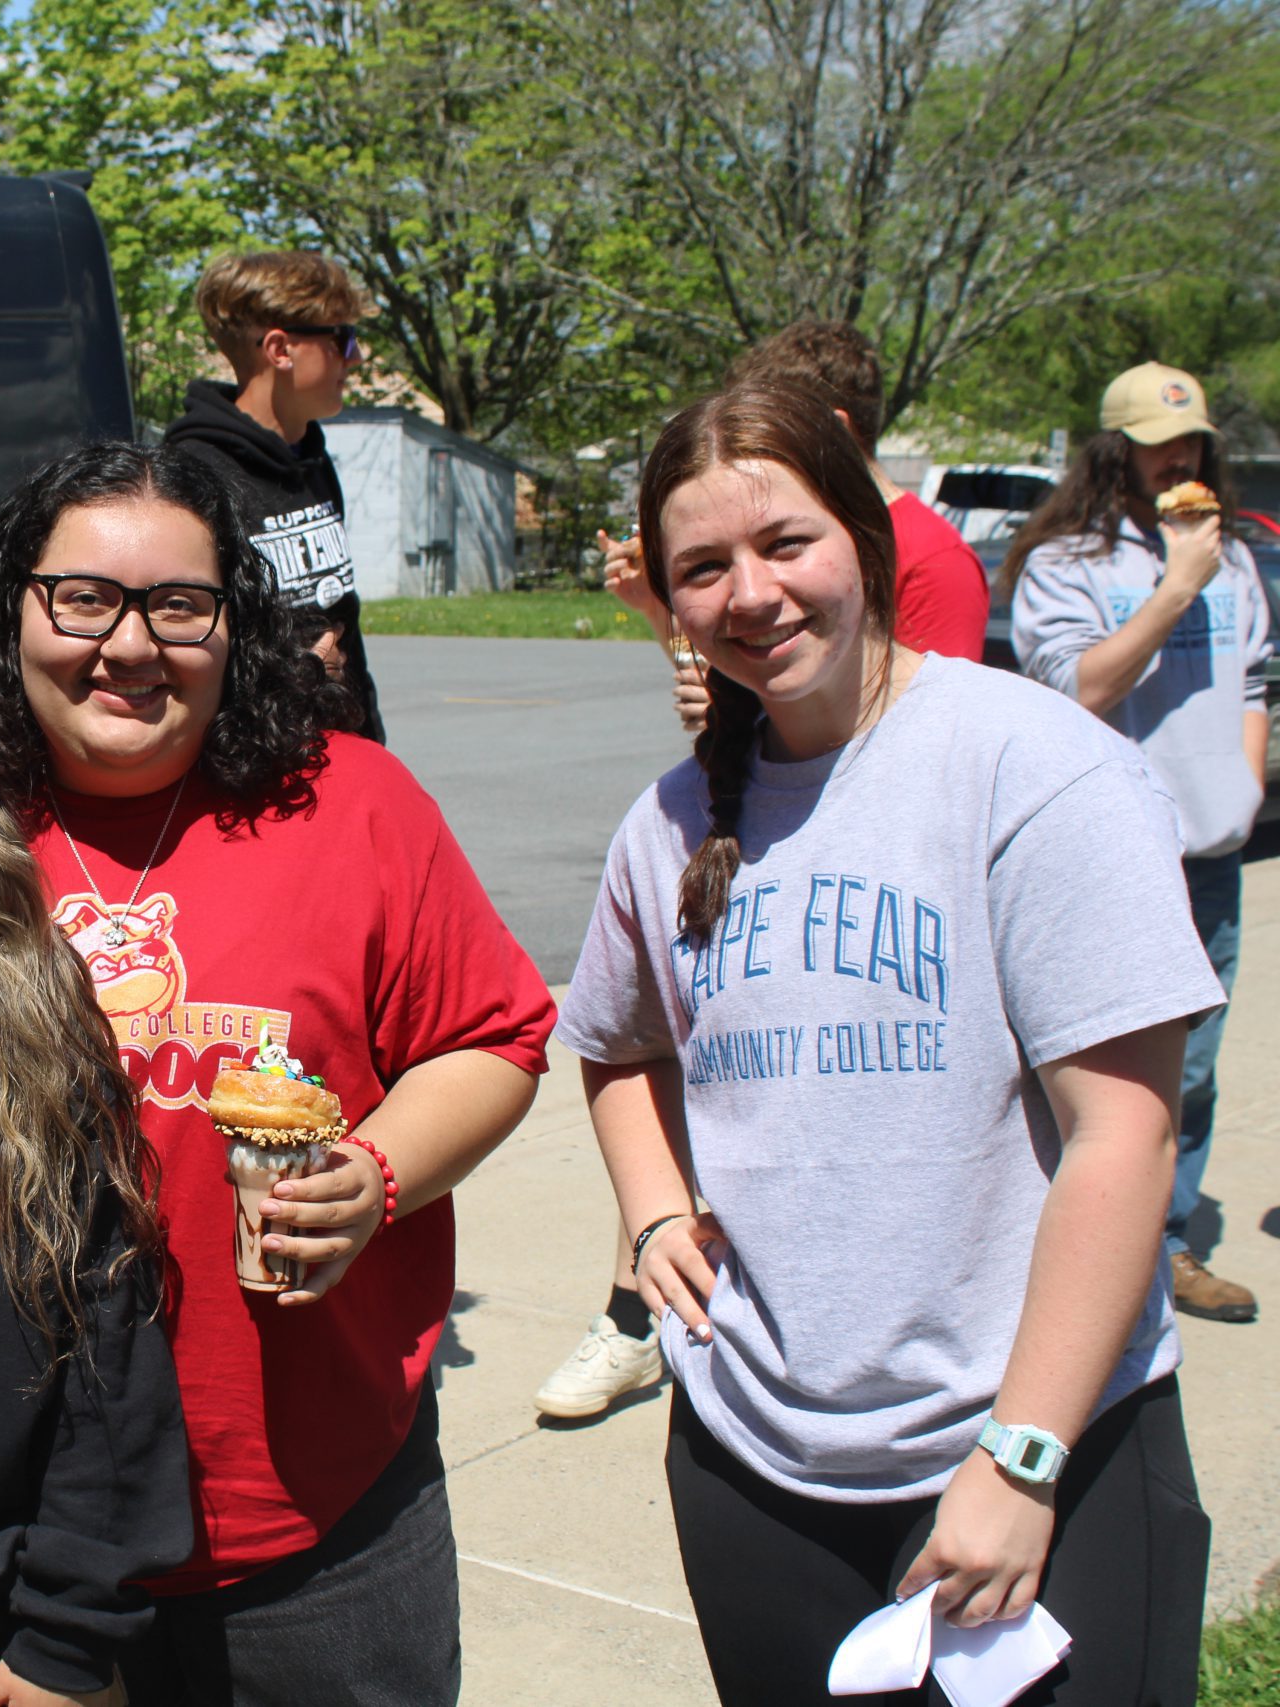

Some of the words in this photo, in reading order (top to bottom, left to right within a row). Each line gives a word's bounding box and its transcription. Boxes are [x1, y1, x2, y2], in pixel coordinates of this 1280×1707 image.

[264, 500, 335, 532] SUPPORT
[804, 873, 950, 1016] FEAR
[129, 1012, 254, 1039] COLLEGE
[818, 1019, 948, 1075] COLLEGE
